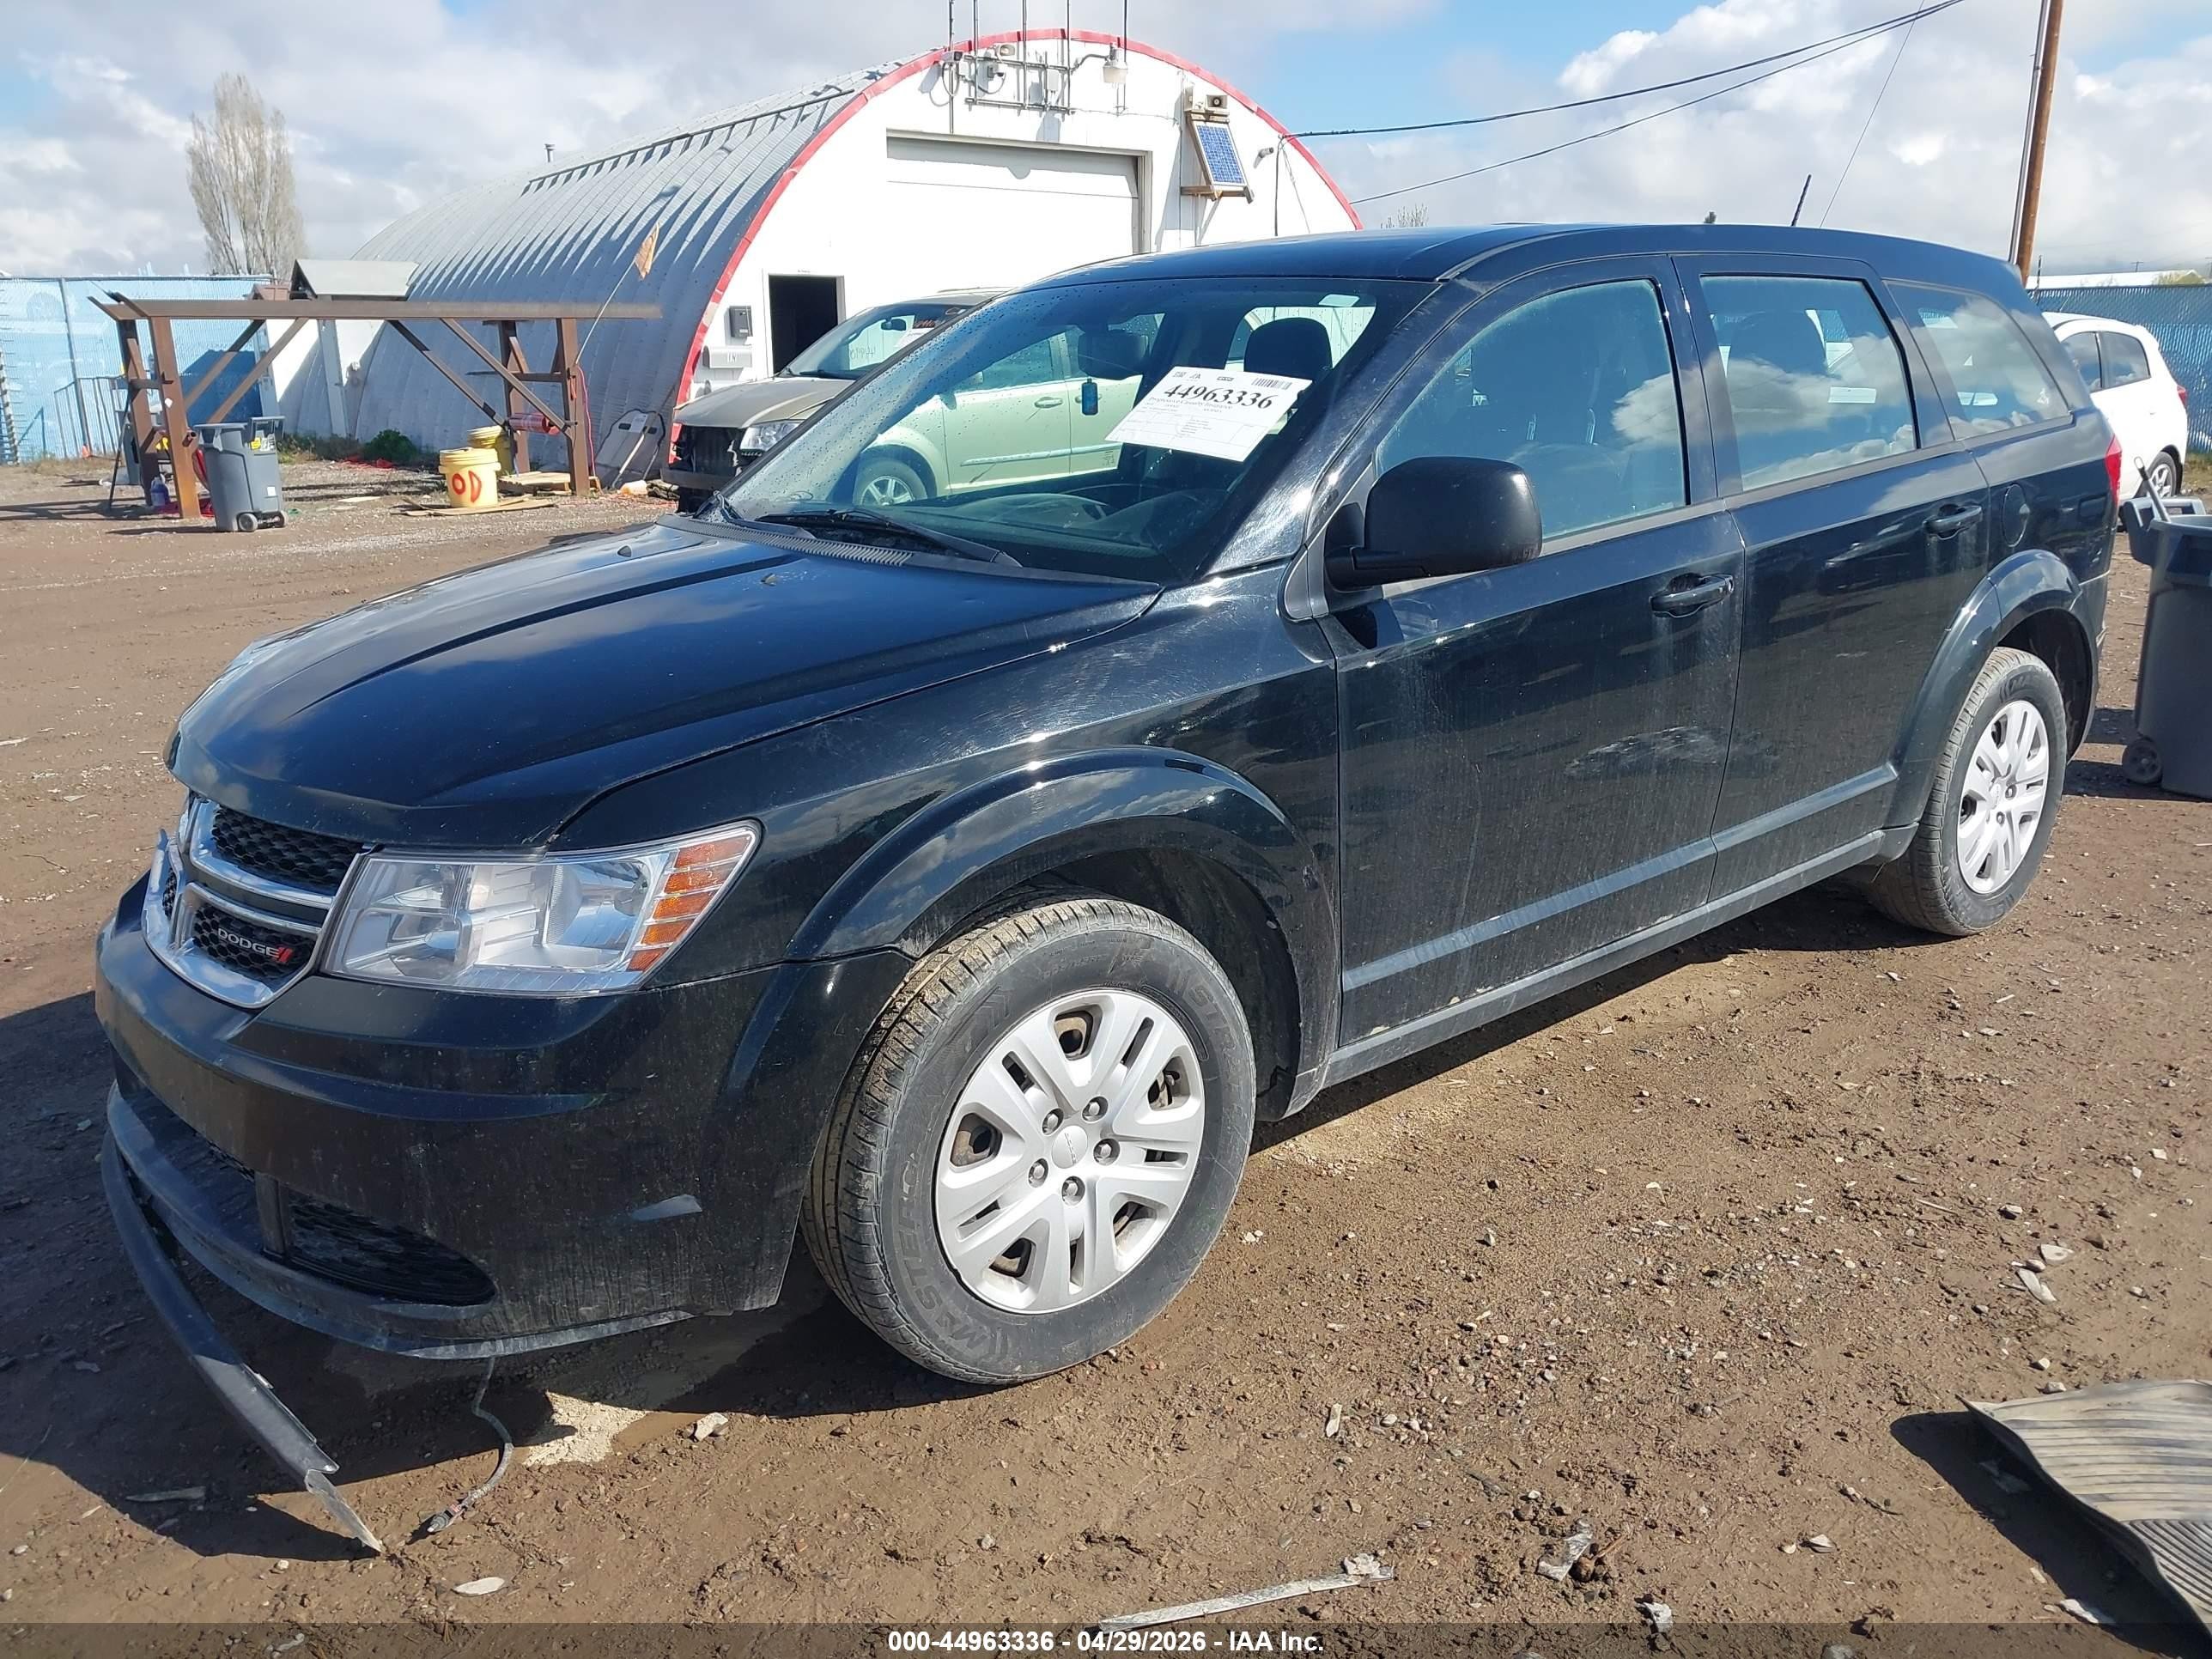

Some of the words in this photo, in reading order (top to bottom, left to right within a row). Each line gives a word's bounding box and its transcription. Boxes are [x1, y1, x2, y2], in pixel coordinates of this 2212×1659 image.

[1164, 384, 1279, 409] 44963336
[452, 470, 483, 503] OD
[218, 928, 279, 958] DODGE
